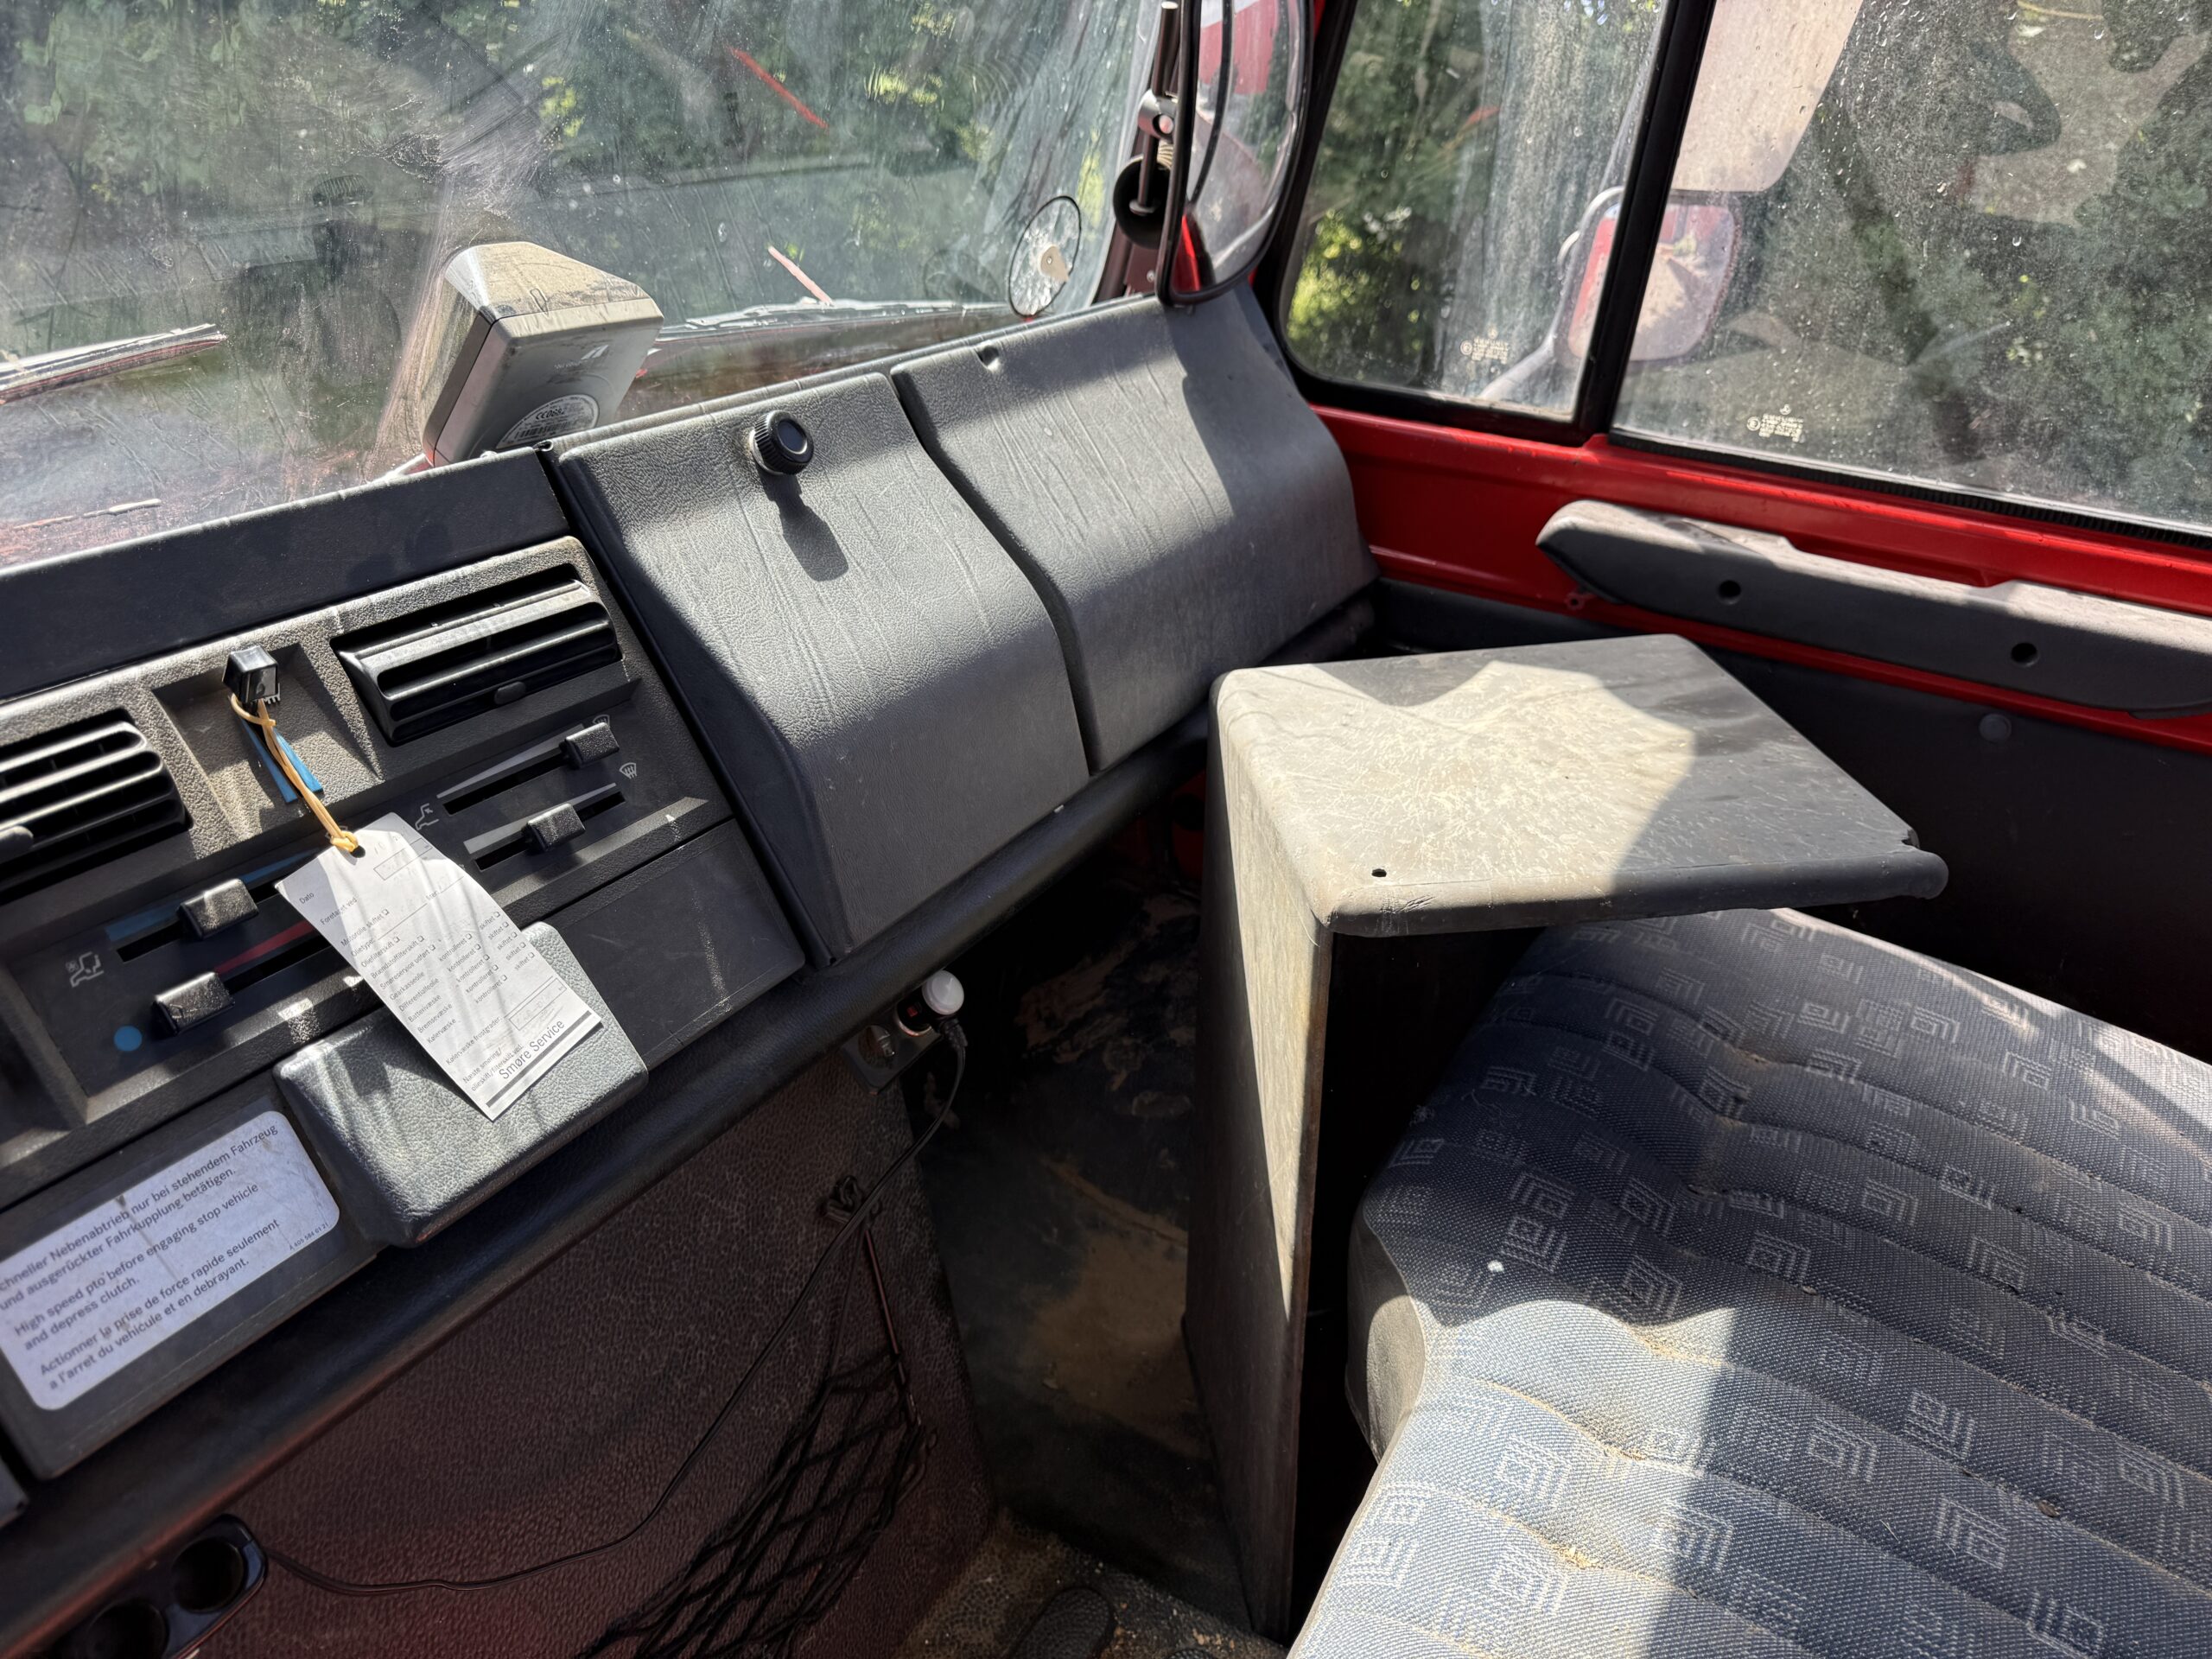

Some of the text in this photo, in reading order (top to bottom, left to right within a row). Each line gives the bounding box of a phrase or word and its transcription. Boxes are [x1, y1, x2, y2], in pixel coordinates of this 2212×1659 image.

[298, 892, 315, 904] Dato
[340, 912, 385, 946] Motorolie skiftet
[360, 941, 394, 968] Oliefilterskift
[379, 948, 430, 989] Smøreservice udført
[389, 915, 496, 1001] Gearkasseolie kontrolleret skiftet
[407, 935, 513, 1022] Batterivæske kontrolleret skiftet
[416, 945, 522, 1033] Bremsevæske kontrolleret skiftet
[446, 948, 476, 972] kontrolleret
[486, 925, 504, 940] skiftet
[426, 956, 530, 1044] Kølervæske kontrolleret skiftet
[461, 1067, 480, 1084] Næste
[498, 1020, 564, 1079] Smøre Service
[0, 1125, 278, 1291] chneller Nebenabtrieb nur bei stehendem Fahrzeug
[0, 1168, 235, 1310] und ausgerückter Fahrkupplung betätigen.
[13, 1184, 258, 1336] High speed pto before engaging stop vehicle
[41, 1218, 279, 1375] Actionner la prise de force rapide seulement
[26, 1277, 139, 1350] and depress clutch.
[57, 1354, 97, 1383] l'arret
[97, 1344, 114, 1358] du
[114, 1313, 162, 1346] vehicule
[163, 1302, 176, 1315] et
[177, 1294, 193, 1306] en
[193, 1257, 249, 1296] debrayant.
